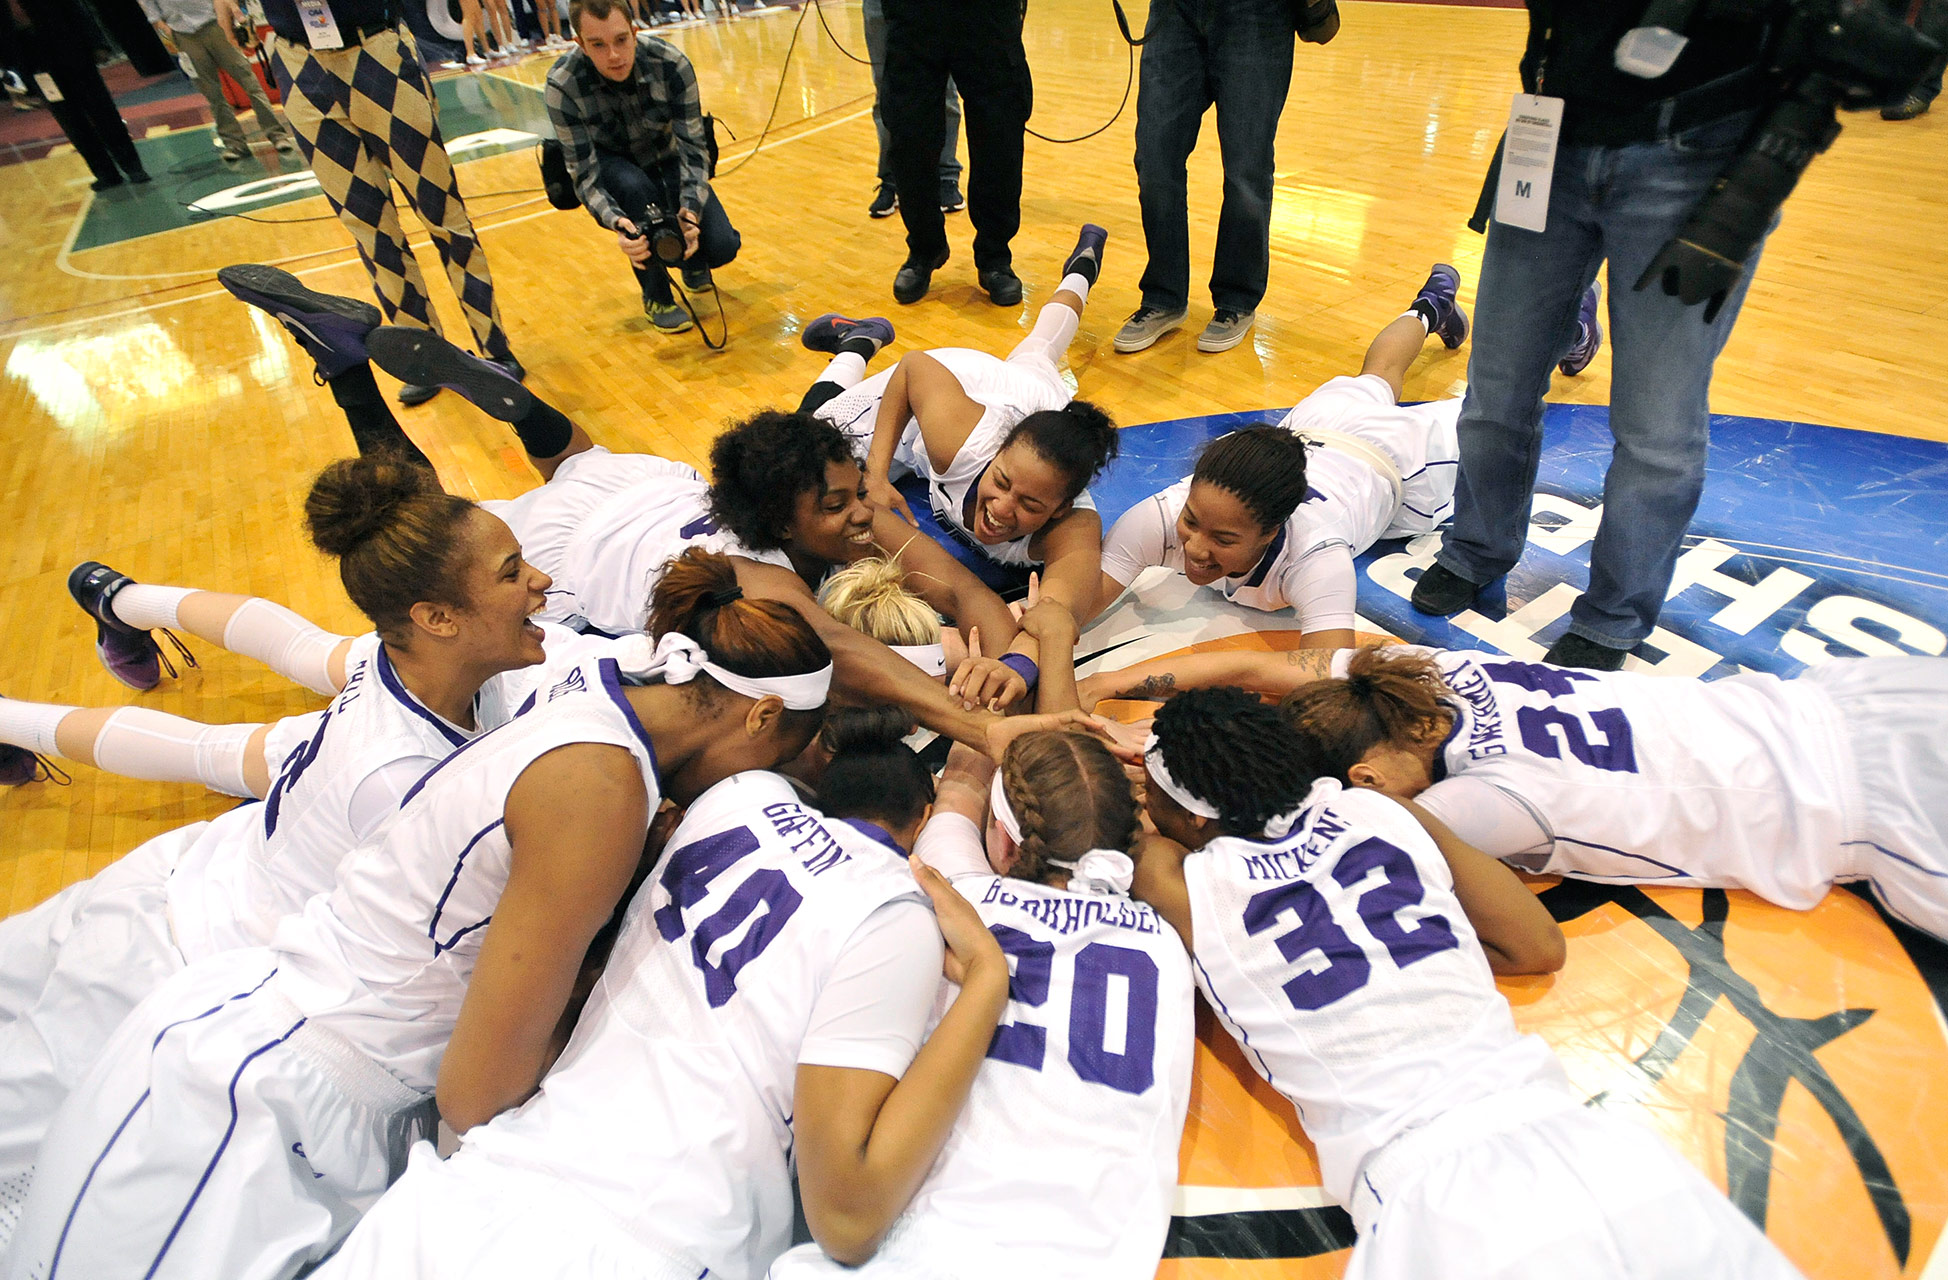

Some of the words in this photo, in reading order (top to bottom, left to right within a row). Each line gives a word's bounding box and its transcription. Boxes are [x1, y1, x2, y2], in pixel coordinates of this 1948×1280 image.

[1515, 180, 1532, 198] M
[1481, 661, 1639, 774] 24
[654, 825, 804, 1009] 40
[1243, 836, 1459, 1011] 32
[985, 923, 1159, 1096] 20
